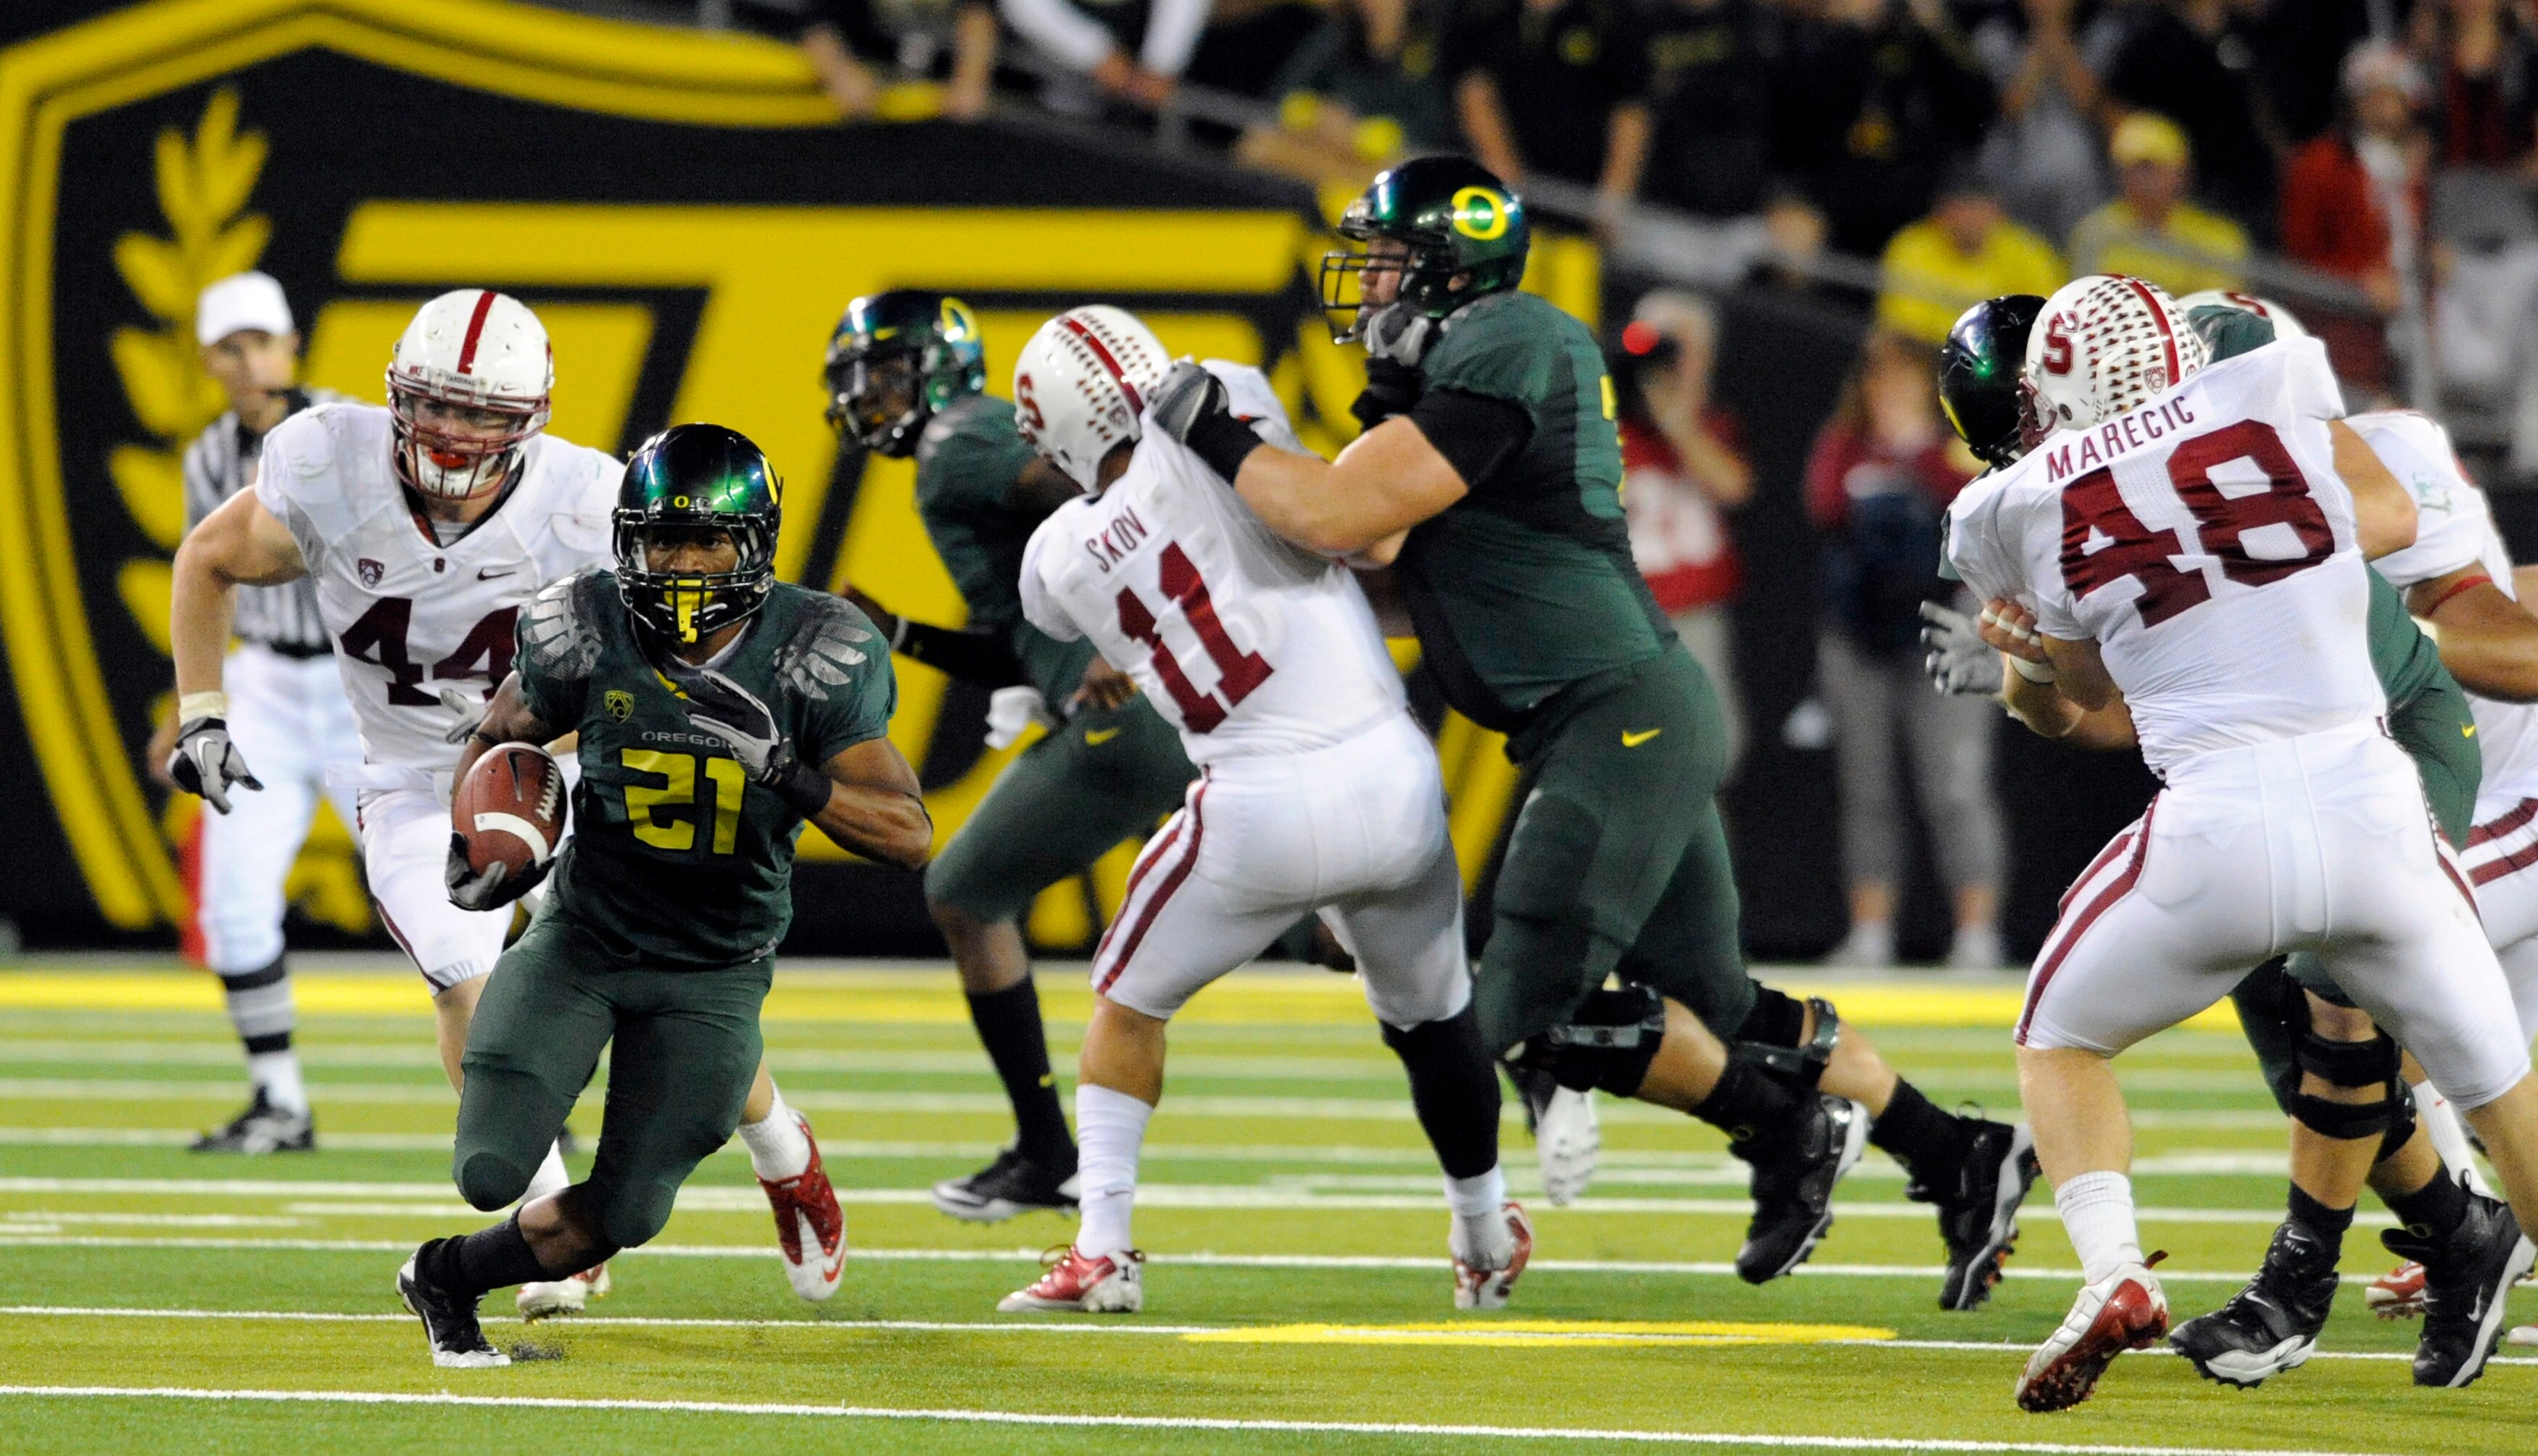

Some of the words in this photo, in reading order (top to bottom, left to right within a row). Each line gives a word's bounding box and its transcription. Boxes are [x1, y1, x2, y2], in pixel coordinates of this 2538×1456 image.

[1451, 186, 1507, 240] O
[2042, 310, 2080, 376] S
[2046, 395, 2194, 484] MARECIC
[674, 496, 689, 508] O
[1086, 505, 1147, 573] SKOV
[2059, 418, 2335, 629] 48
[339, 597, 519, 706] 44
[1116, 539, 1274, 734] 11
[621, 748, 745, 854] 21
